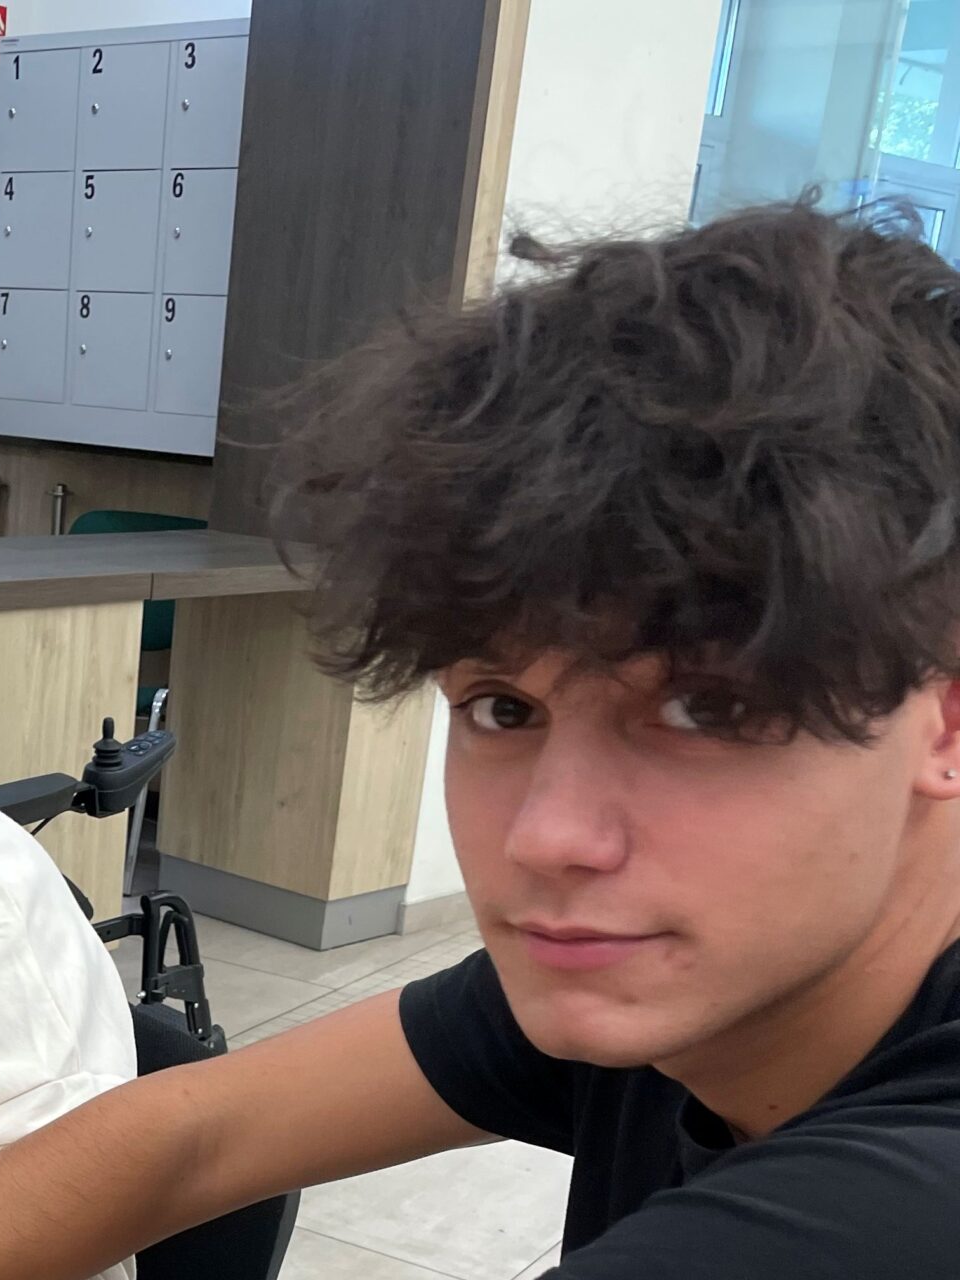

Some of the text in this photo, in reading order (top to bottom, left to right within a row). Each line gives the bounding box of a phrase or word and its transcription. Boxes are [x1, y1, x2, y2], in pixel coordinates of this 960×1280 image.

[13, 55, 20, 80] 1
[92, 48, 103, 75] 2
[184, 42, 196, 70] 3
[4, 176, 15, 201] 4
[84, 174, 95, 200] 5
[172, 172, 185, 198] 6
[0, 292, 10, 316] 7
[79, 294, 91, 319] 8
[164, 297, 176, 323] 9
